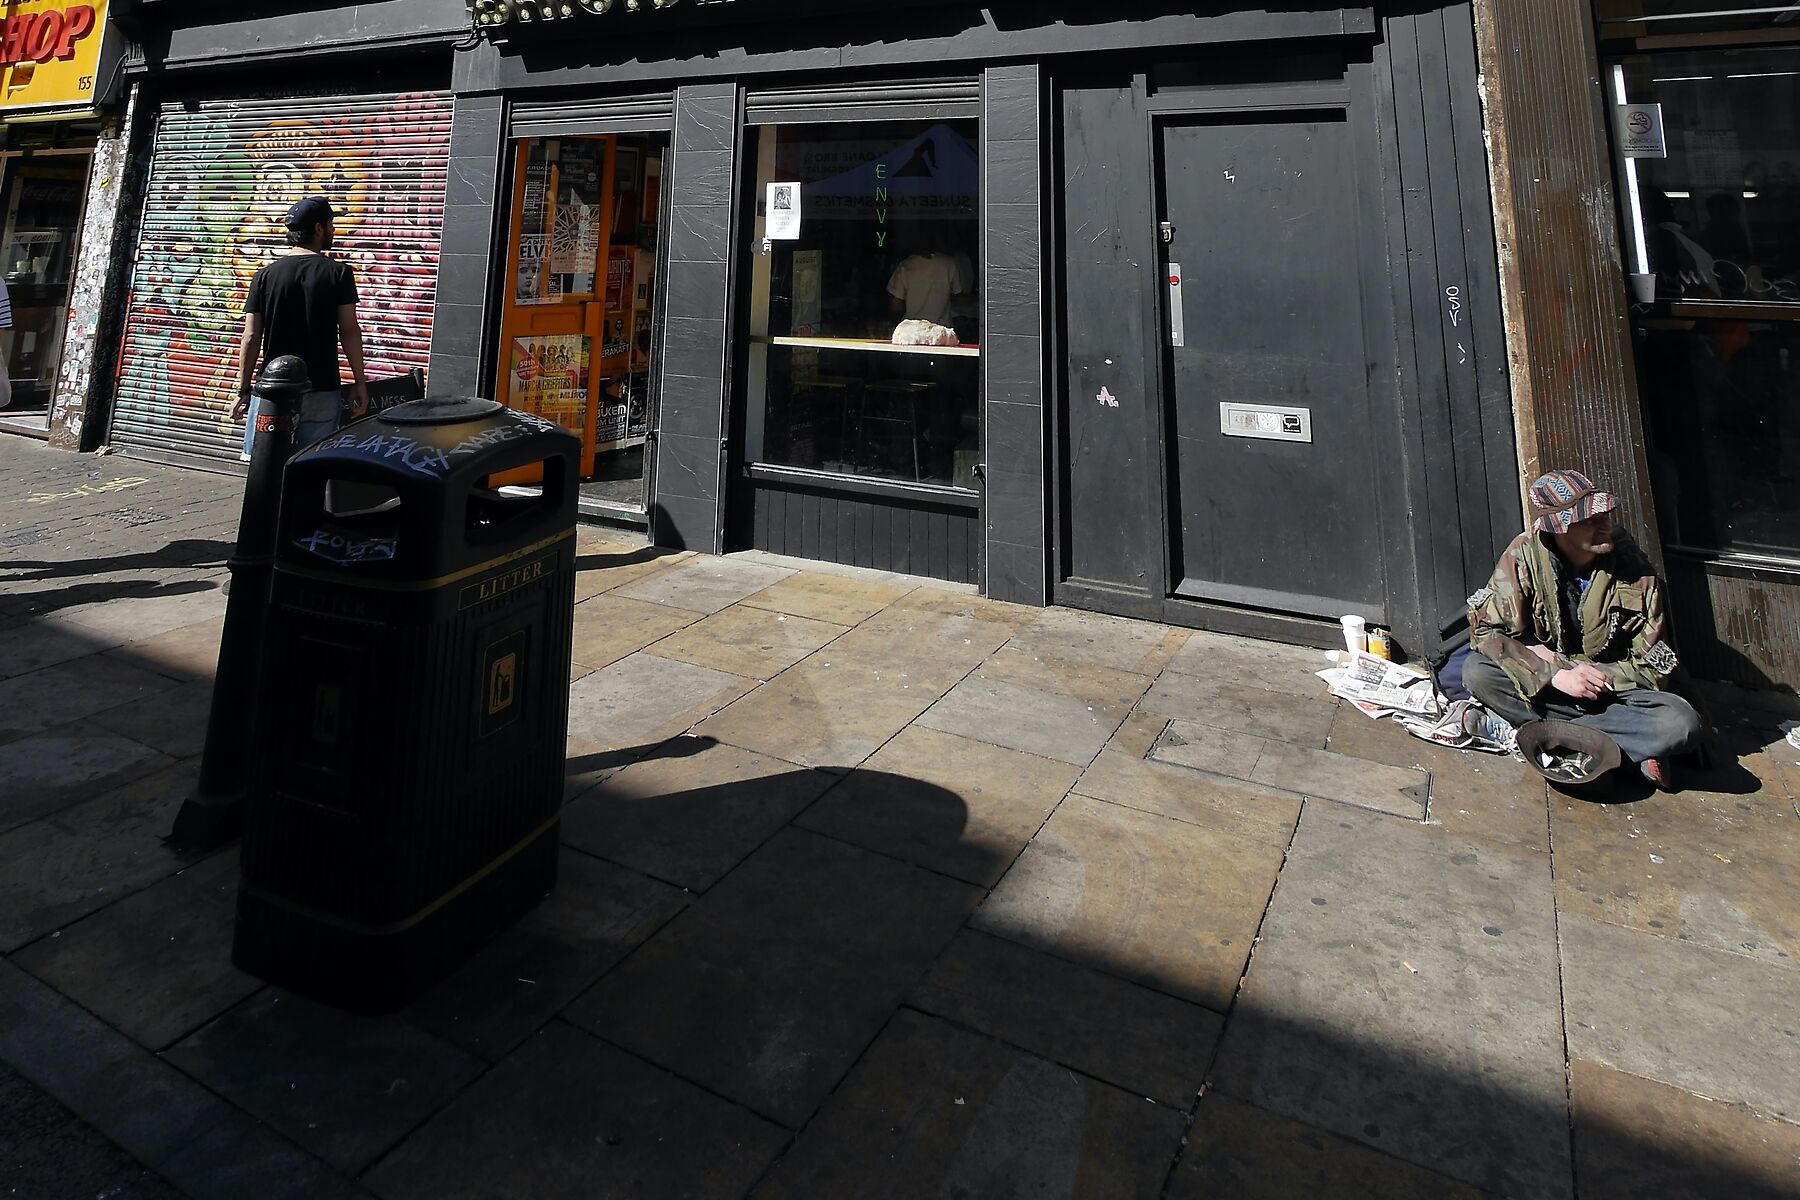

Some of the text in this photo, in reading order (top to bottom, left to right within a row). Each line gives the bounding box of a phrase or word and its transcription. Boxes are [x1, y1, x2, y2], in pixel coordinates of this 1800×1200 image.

[0, 5, 96, 64] HOP
[78, 75, 93, 91] 155
[480, 562, 543, 599] LITTER
